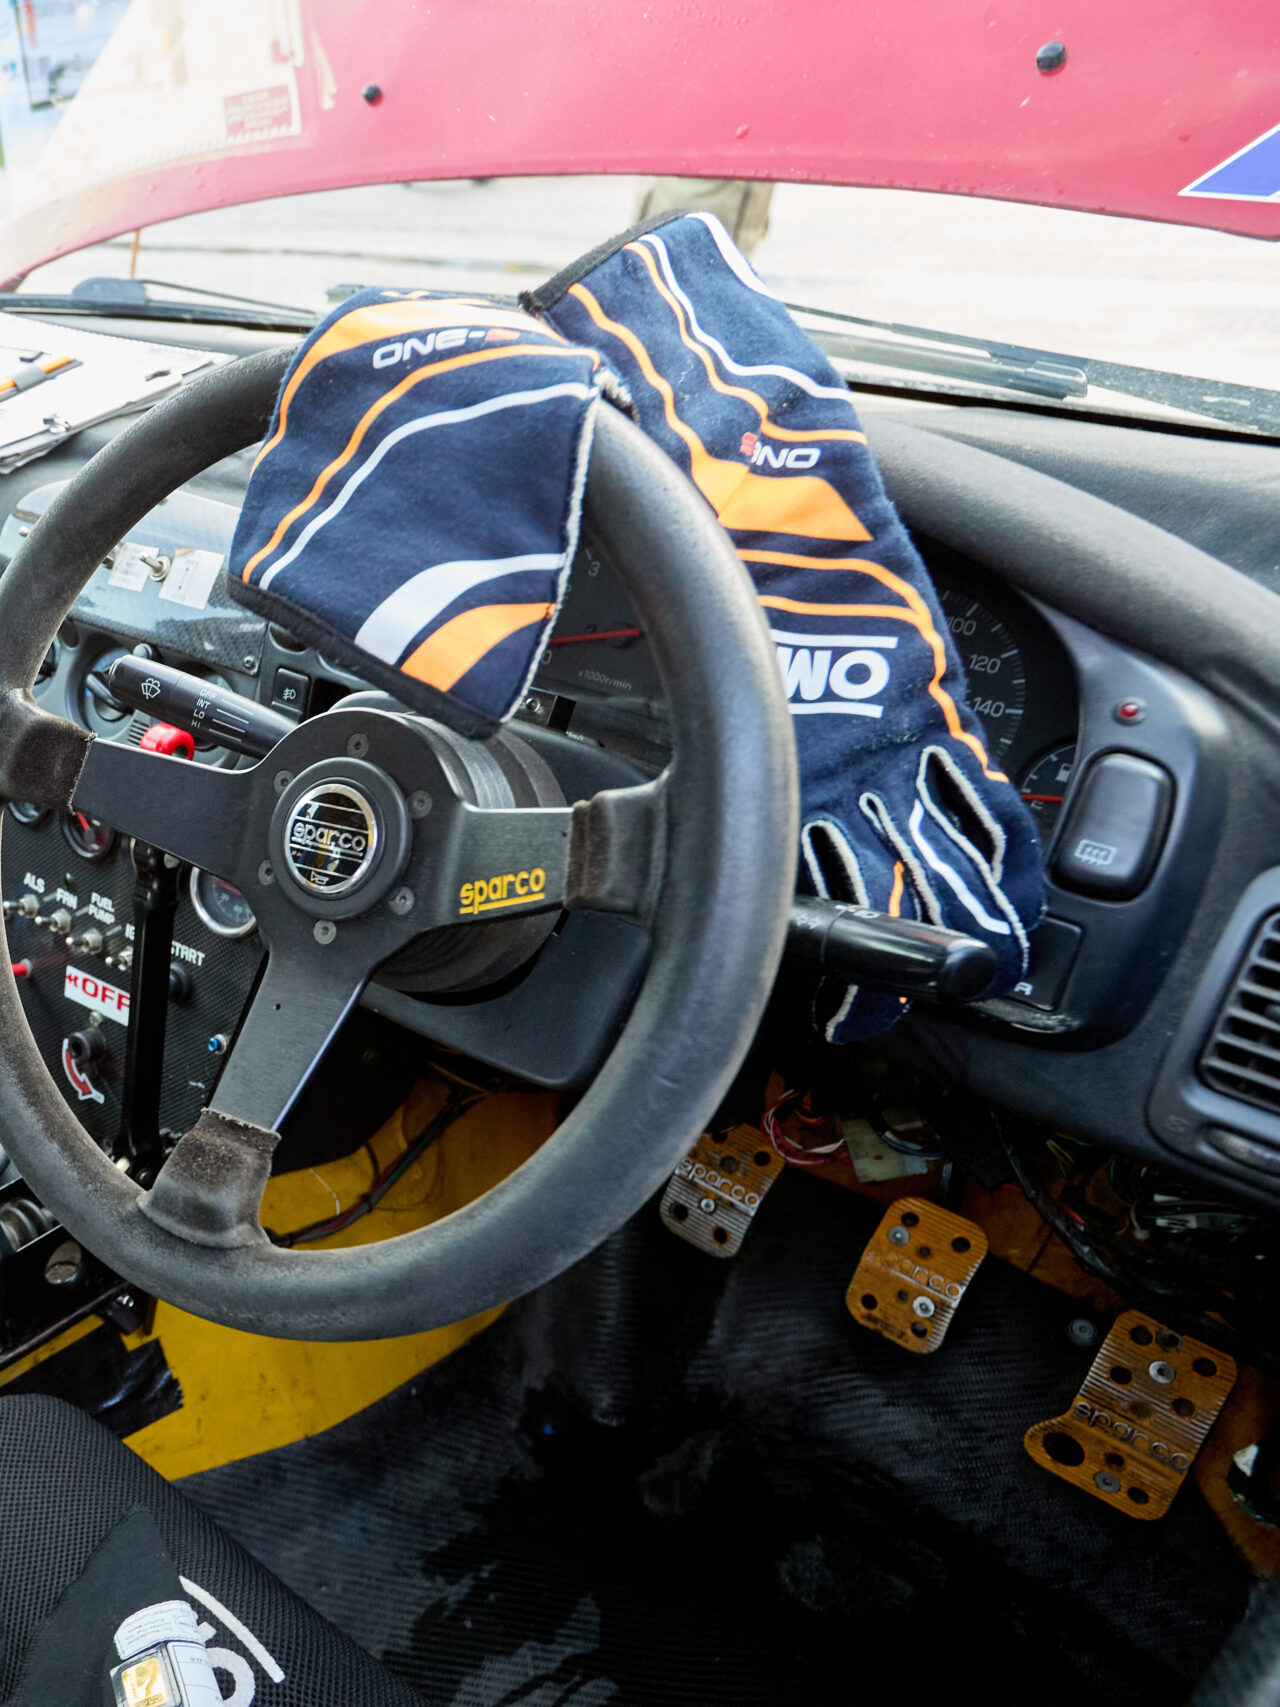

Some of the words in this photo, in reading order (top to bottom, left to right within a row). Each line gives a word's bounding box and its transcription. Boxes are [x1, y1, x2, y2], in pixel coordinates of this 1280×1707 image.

[776, 646, 891, 701] OM
[970, 654, 1000, 674] 120
[193, 708, 205, 720] LO
[196, 698, 211, 709] INT
[973, 697, 1005, 717] 140
[191, 719, 201, 729] HI
[292, 822, 367, 852] sparco
[23, 872, 46, 894] ALS
[460, 867, 546, 915] sparco
[56, 887, 78, 910] FAN
[91, 892, 115, 913] FUEL
[88, 904, 116, 926] PUMP
[81, 976, 131, 1012] OFF
[679, 1156, 760, 1208] sparco
[1073, 1401, 1191, 1471] sparco
